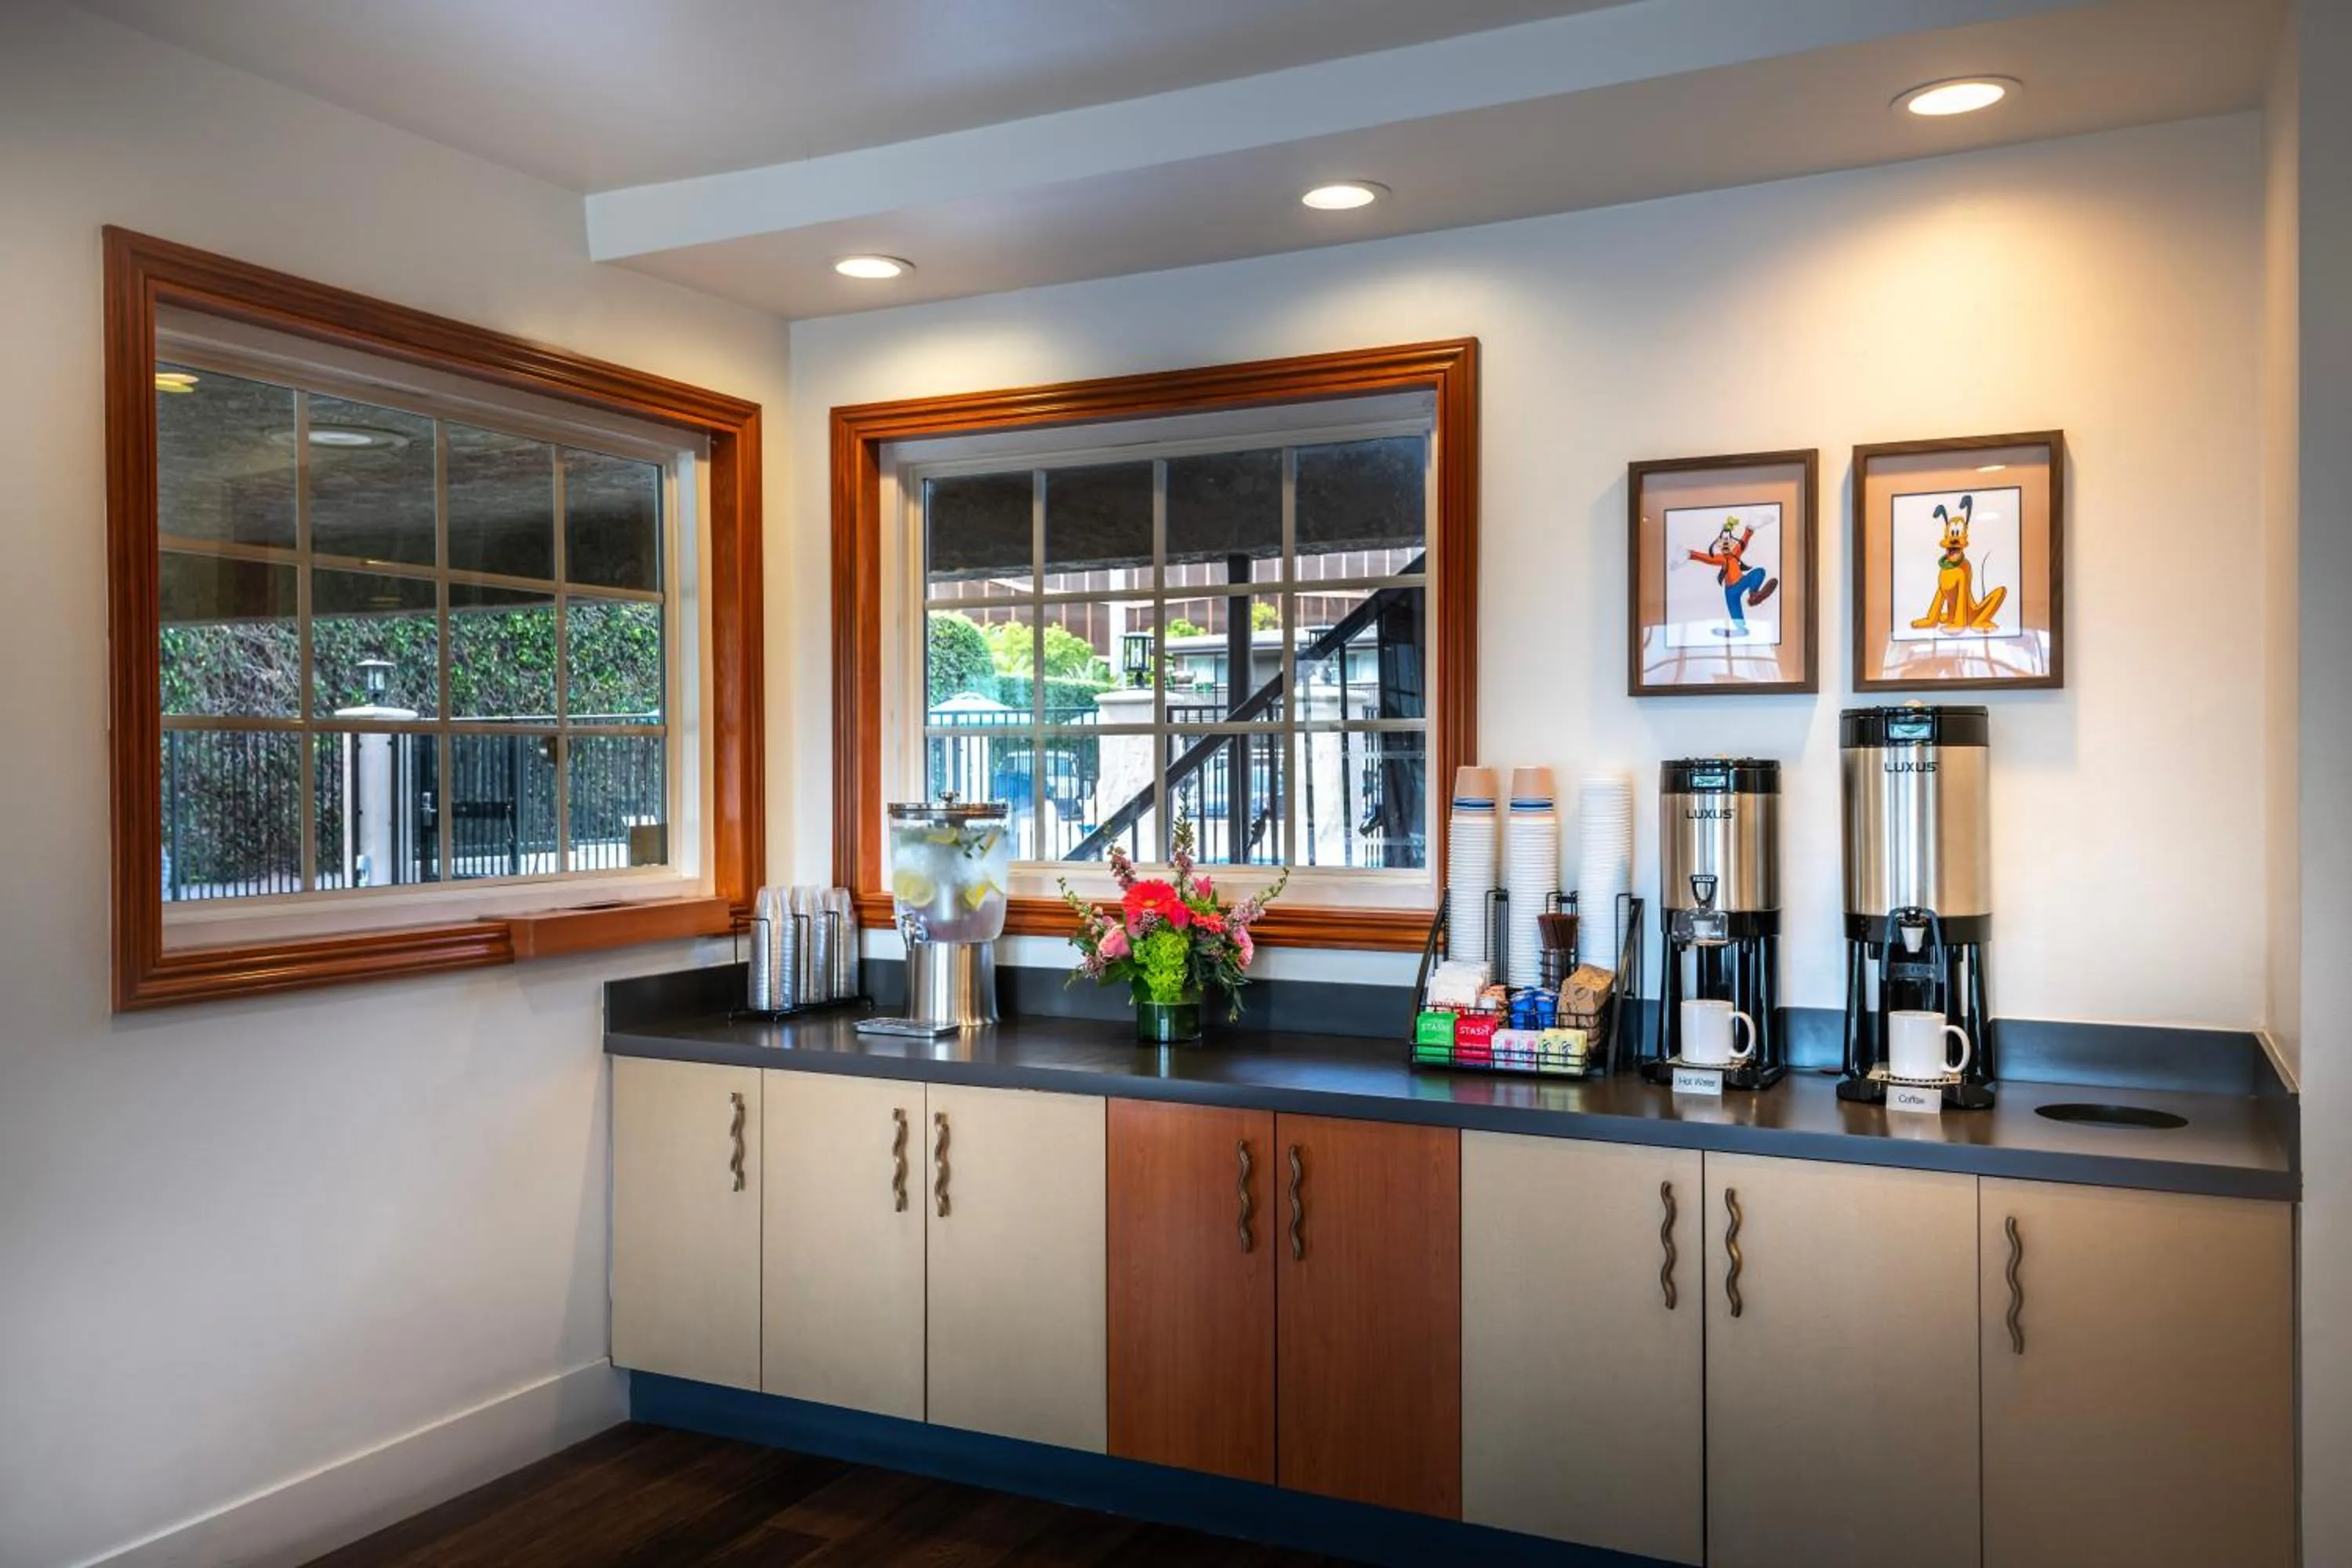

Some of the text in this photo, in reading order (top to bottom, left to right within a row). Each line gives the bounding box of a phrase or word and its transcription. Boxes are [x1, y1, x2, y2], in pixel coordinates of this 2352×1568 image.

[1884, 761, 1939, 772] LUXUS
[1686, 808, 1732, 819] LUXUS
[1459, 1025, 1490, 1036] STASH
